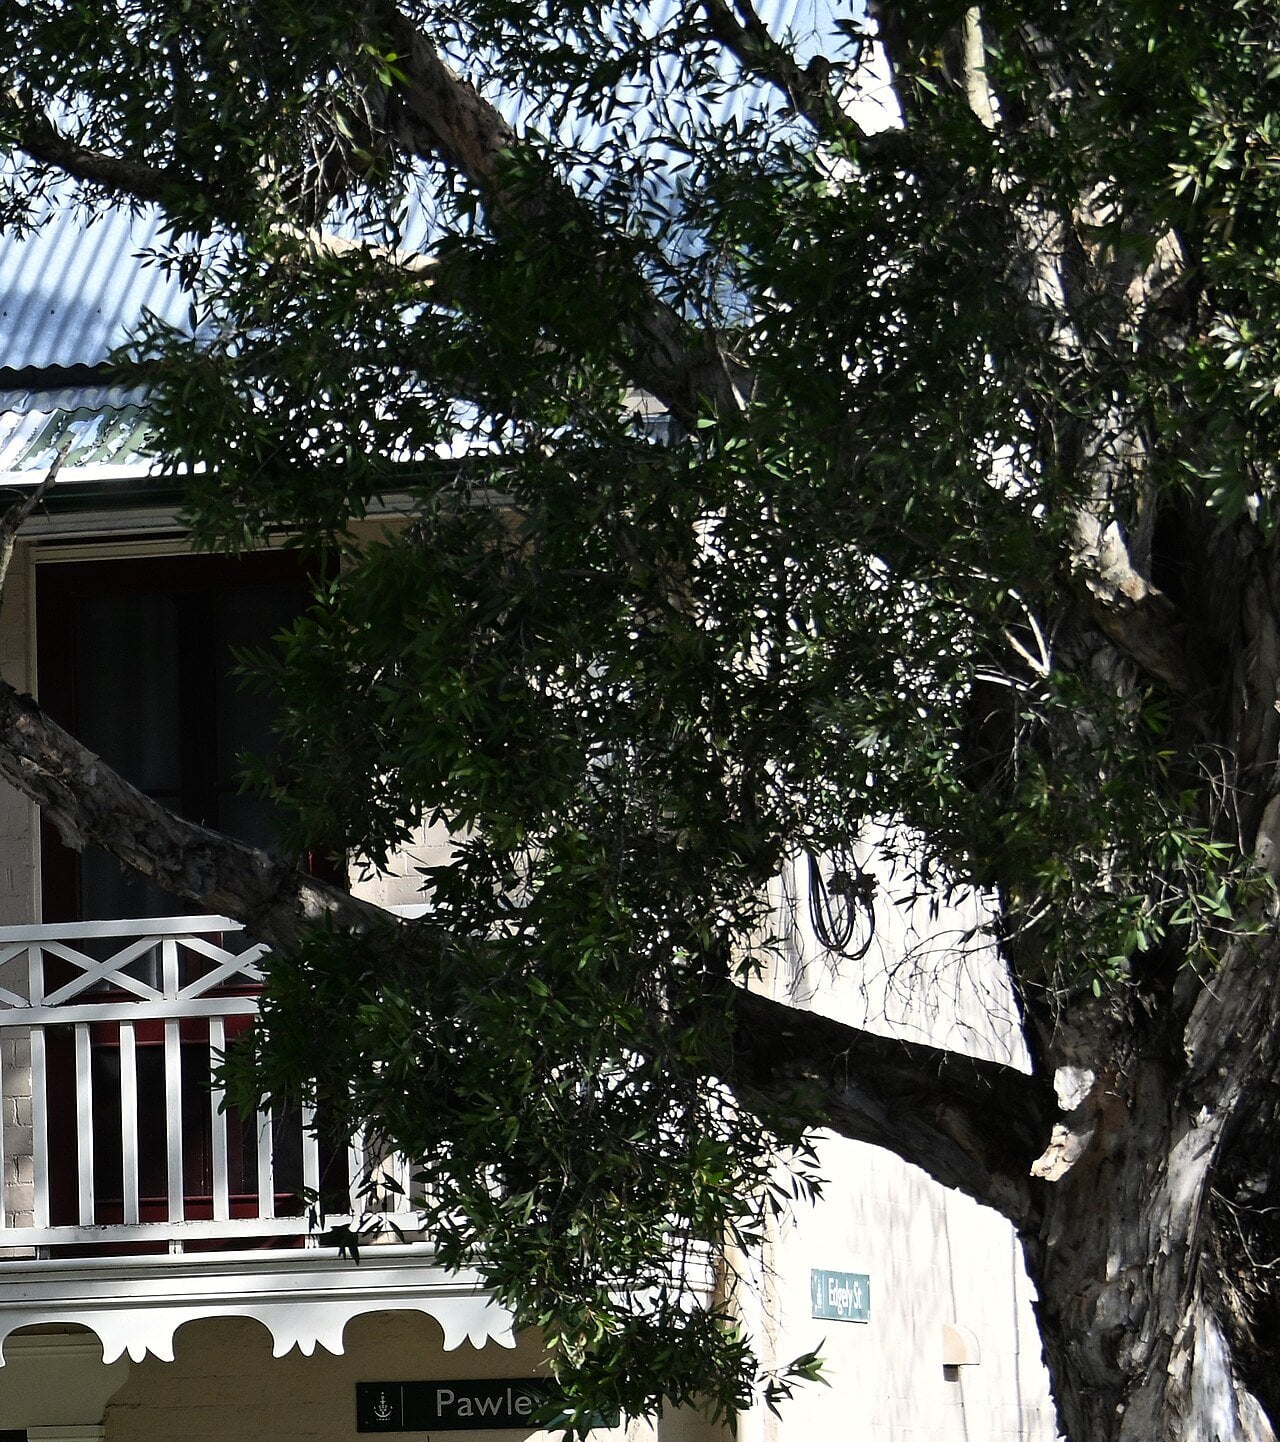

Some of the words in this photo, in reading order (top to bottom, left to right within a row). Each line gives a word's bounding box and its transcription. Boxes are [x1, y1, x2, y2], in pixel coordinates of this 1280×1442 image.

[828, 1277, 852, 1316] Edgely
[853, 1280, 862, 1310] St
[436, 1388, 545, 1417] Pawle
